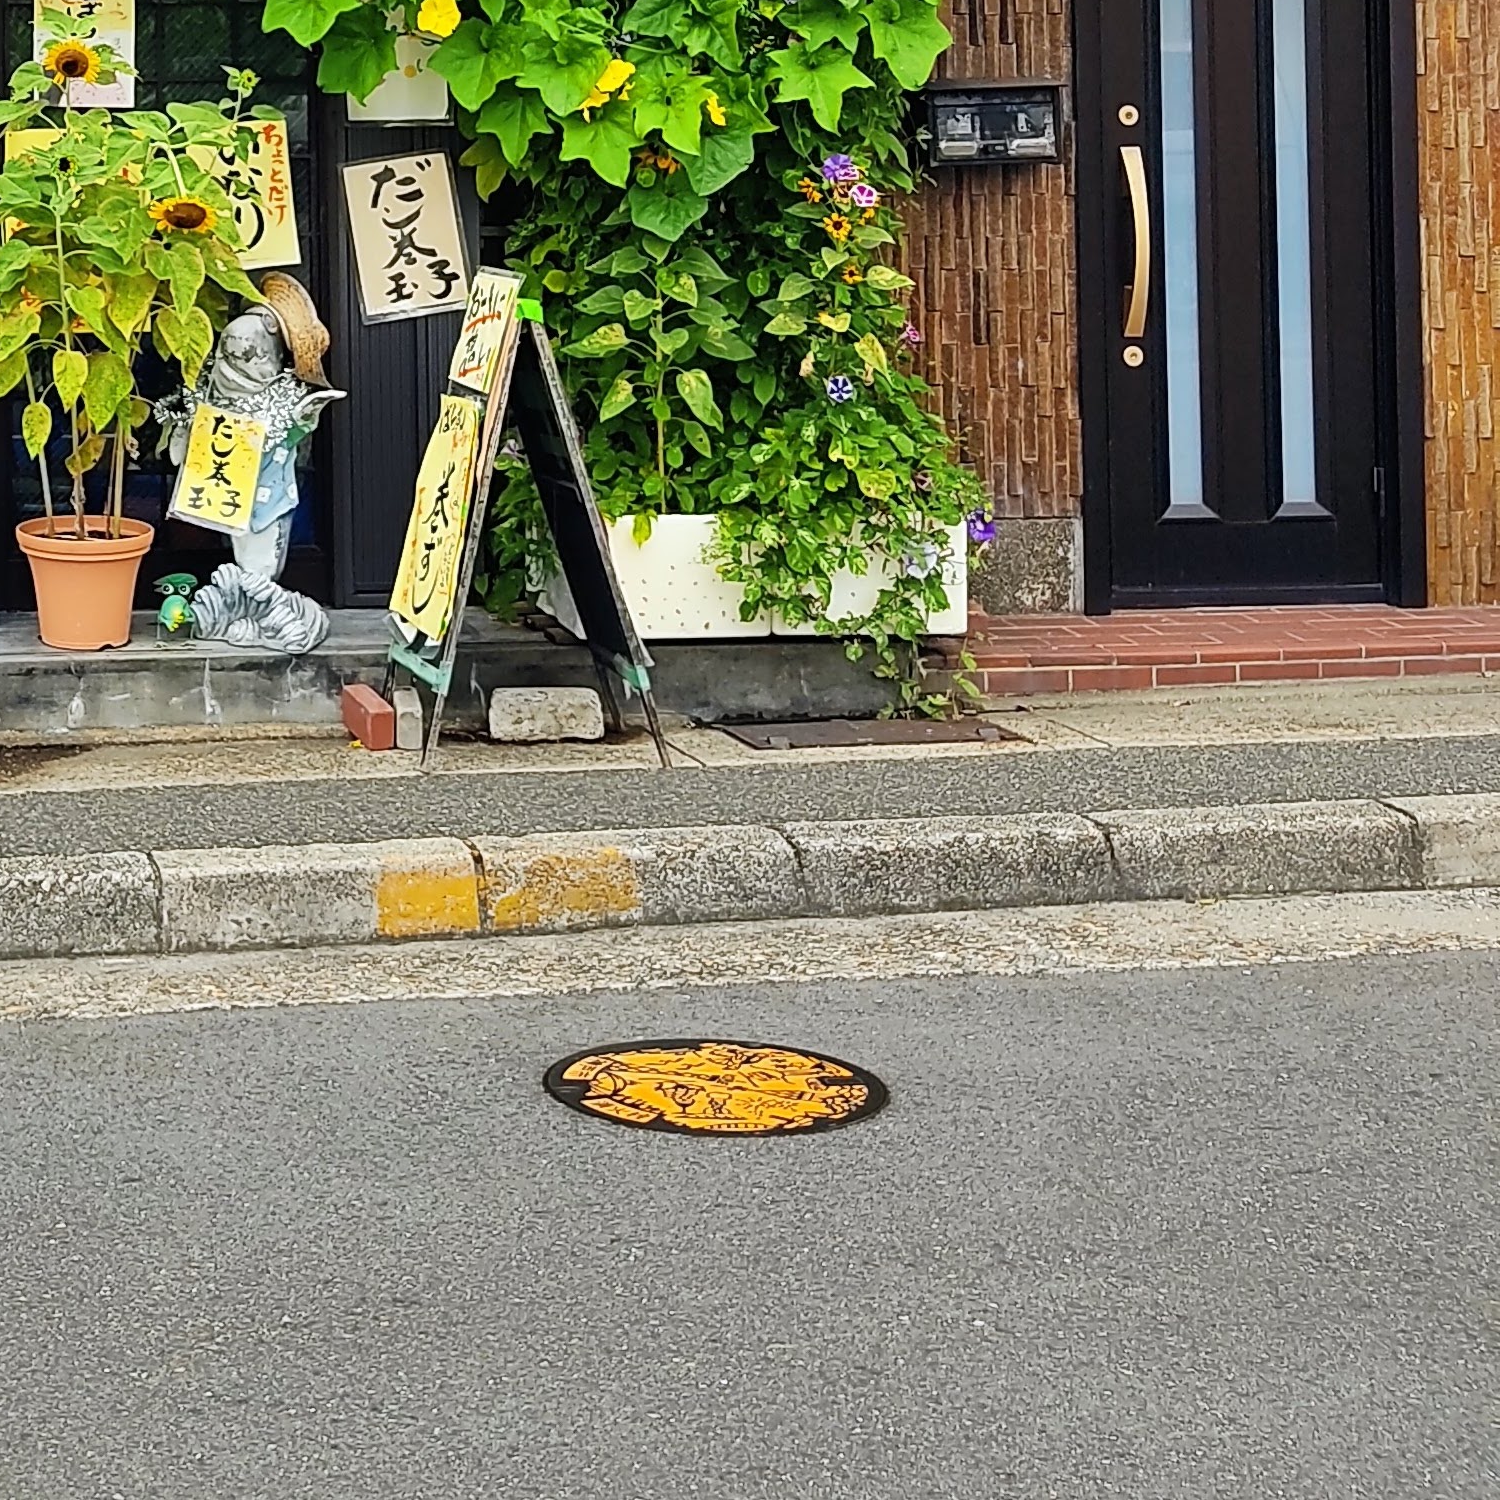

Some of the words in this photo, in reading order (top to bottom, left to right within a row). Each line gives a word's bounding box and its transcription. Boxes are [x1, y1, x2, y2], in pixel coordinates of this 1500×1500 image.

[262, 123, 288, 227] ちょっとだけ
